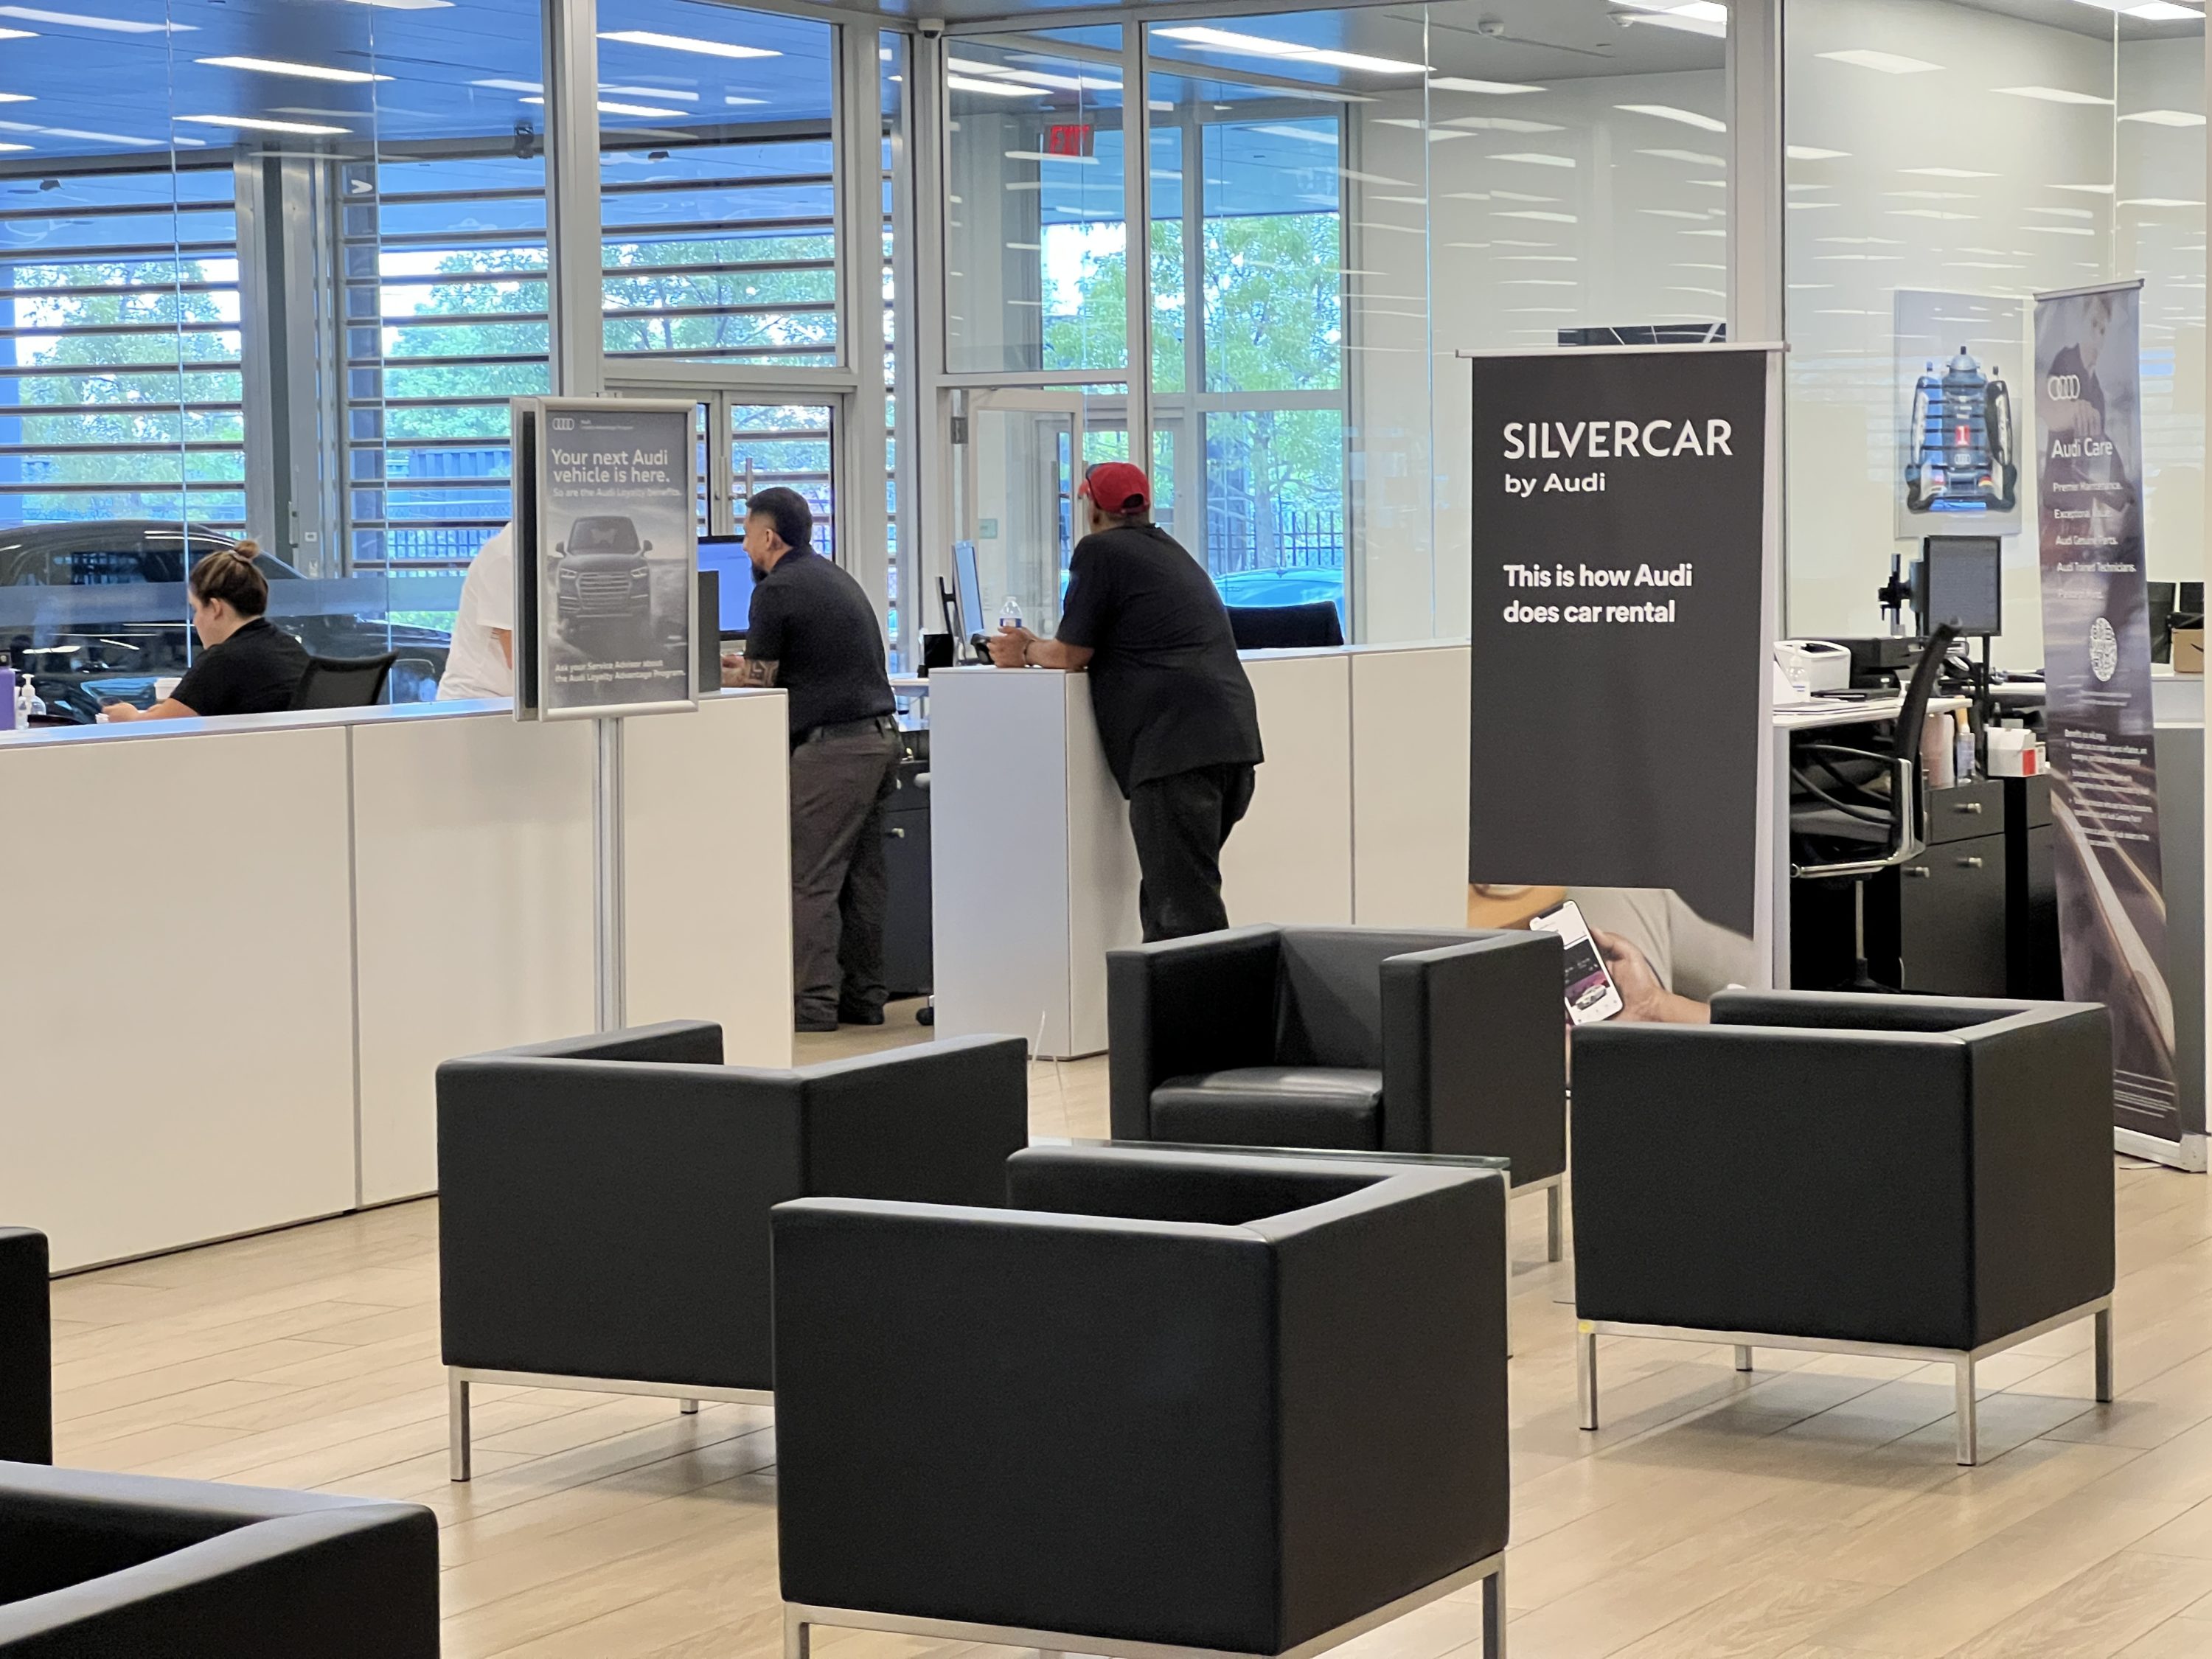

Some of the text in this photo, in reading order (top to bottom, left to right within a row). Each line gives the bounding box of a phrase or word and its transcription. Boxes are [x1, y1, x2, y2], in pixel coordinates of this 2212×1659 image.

[1503, 418, 1733, 460] SILVERCAR
[1958, 425, 1969, 445] 1
[552, 448, 668, 465] Your next Audi
[2051, 437, 2113, 458] Audi Care
[553, 467, 670, 483] vehicle is here.
[1504, 472, 1606, 498] by Audi
[553, 488, 564, 497] So
[580, 487, 595, 497] the
[1503, 563, 1693, 588] This is how Audi
[1503, 599, 1675, 623] does car rental
